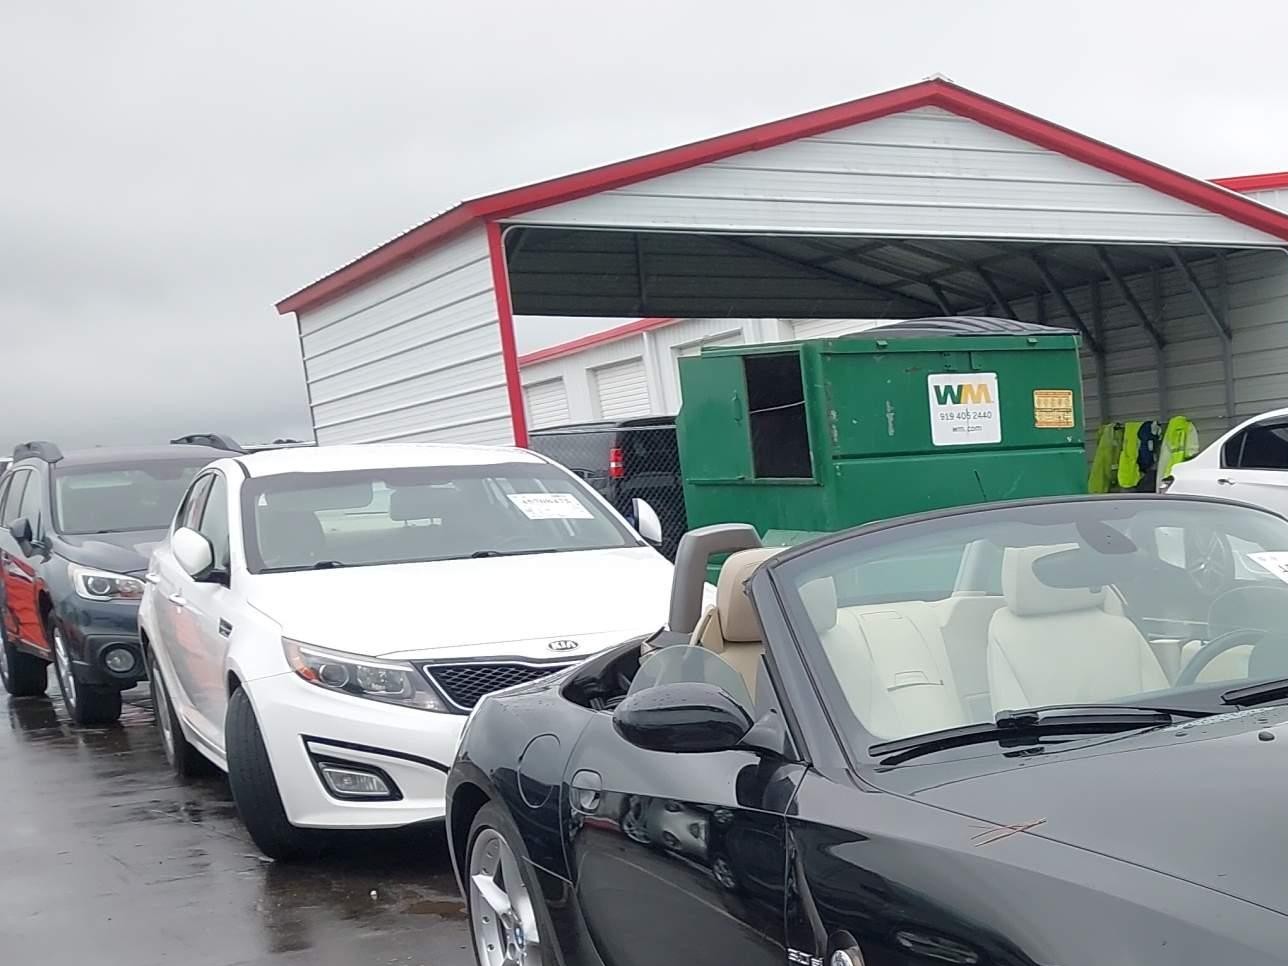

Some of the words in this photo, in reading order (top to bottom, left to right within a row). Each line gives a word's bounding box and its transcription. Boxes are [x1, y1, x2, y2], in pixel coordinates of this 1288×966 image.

[933, 384, 993, 405] WM
[940, 412, 954, 421] 919
[956, 411, 971, 420] 405
[972, 411, 992, 420] 2440
[550, 640, 578, 650] KIA
